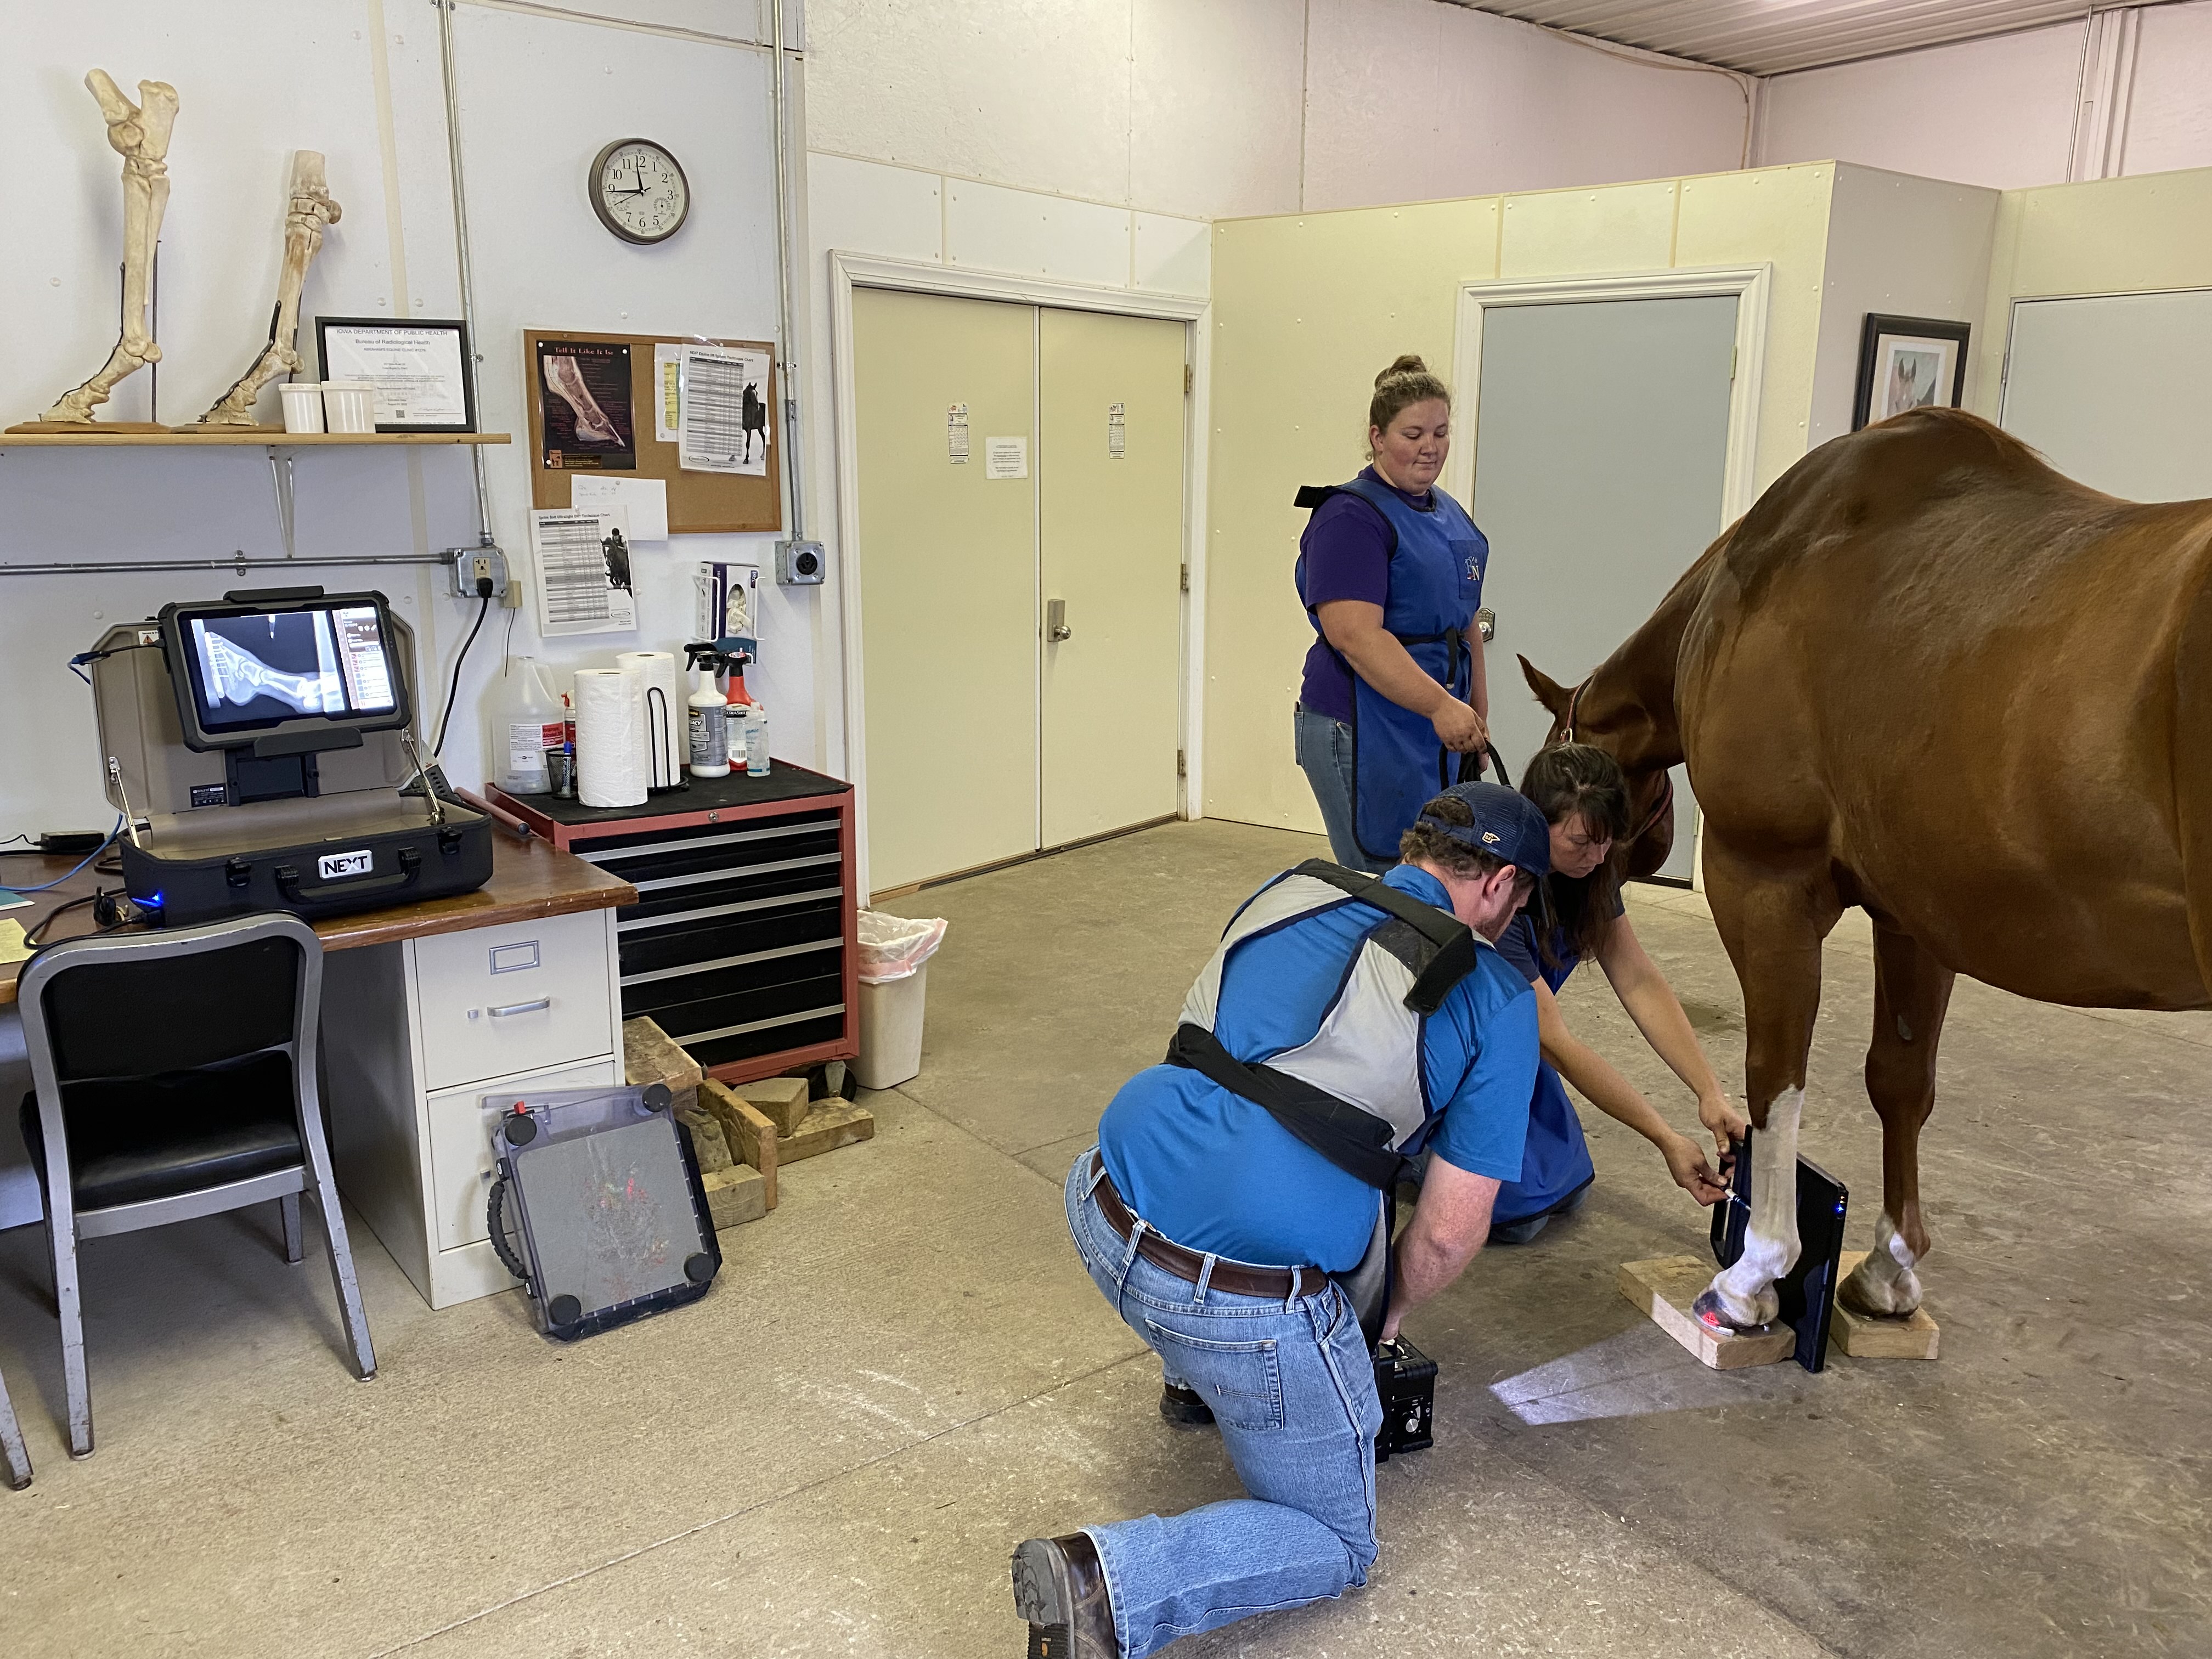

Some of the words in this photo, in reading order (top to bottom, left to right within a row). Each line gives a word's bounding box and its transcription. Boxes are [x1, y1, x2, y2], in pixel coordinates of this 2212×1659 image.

[622, 159, 631, 169] 11
[635, 155, 646, 168] 12
[652, 161, 657, 172] 1
[612, 169, 622, 179] 10
[661, 173, 668, 183] 2
[608, 184, 615, 194] 9
[667, 189, 674, 200] 3
[625, 212, 631, 222] 7
[653, 215, 659, 225] 5
[639, 217, 646, 228] 6
[324, 855, 368, 875] NEXT
